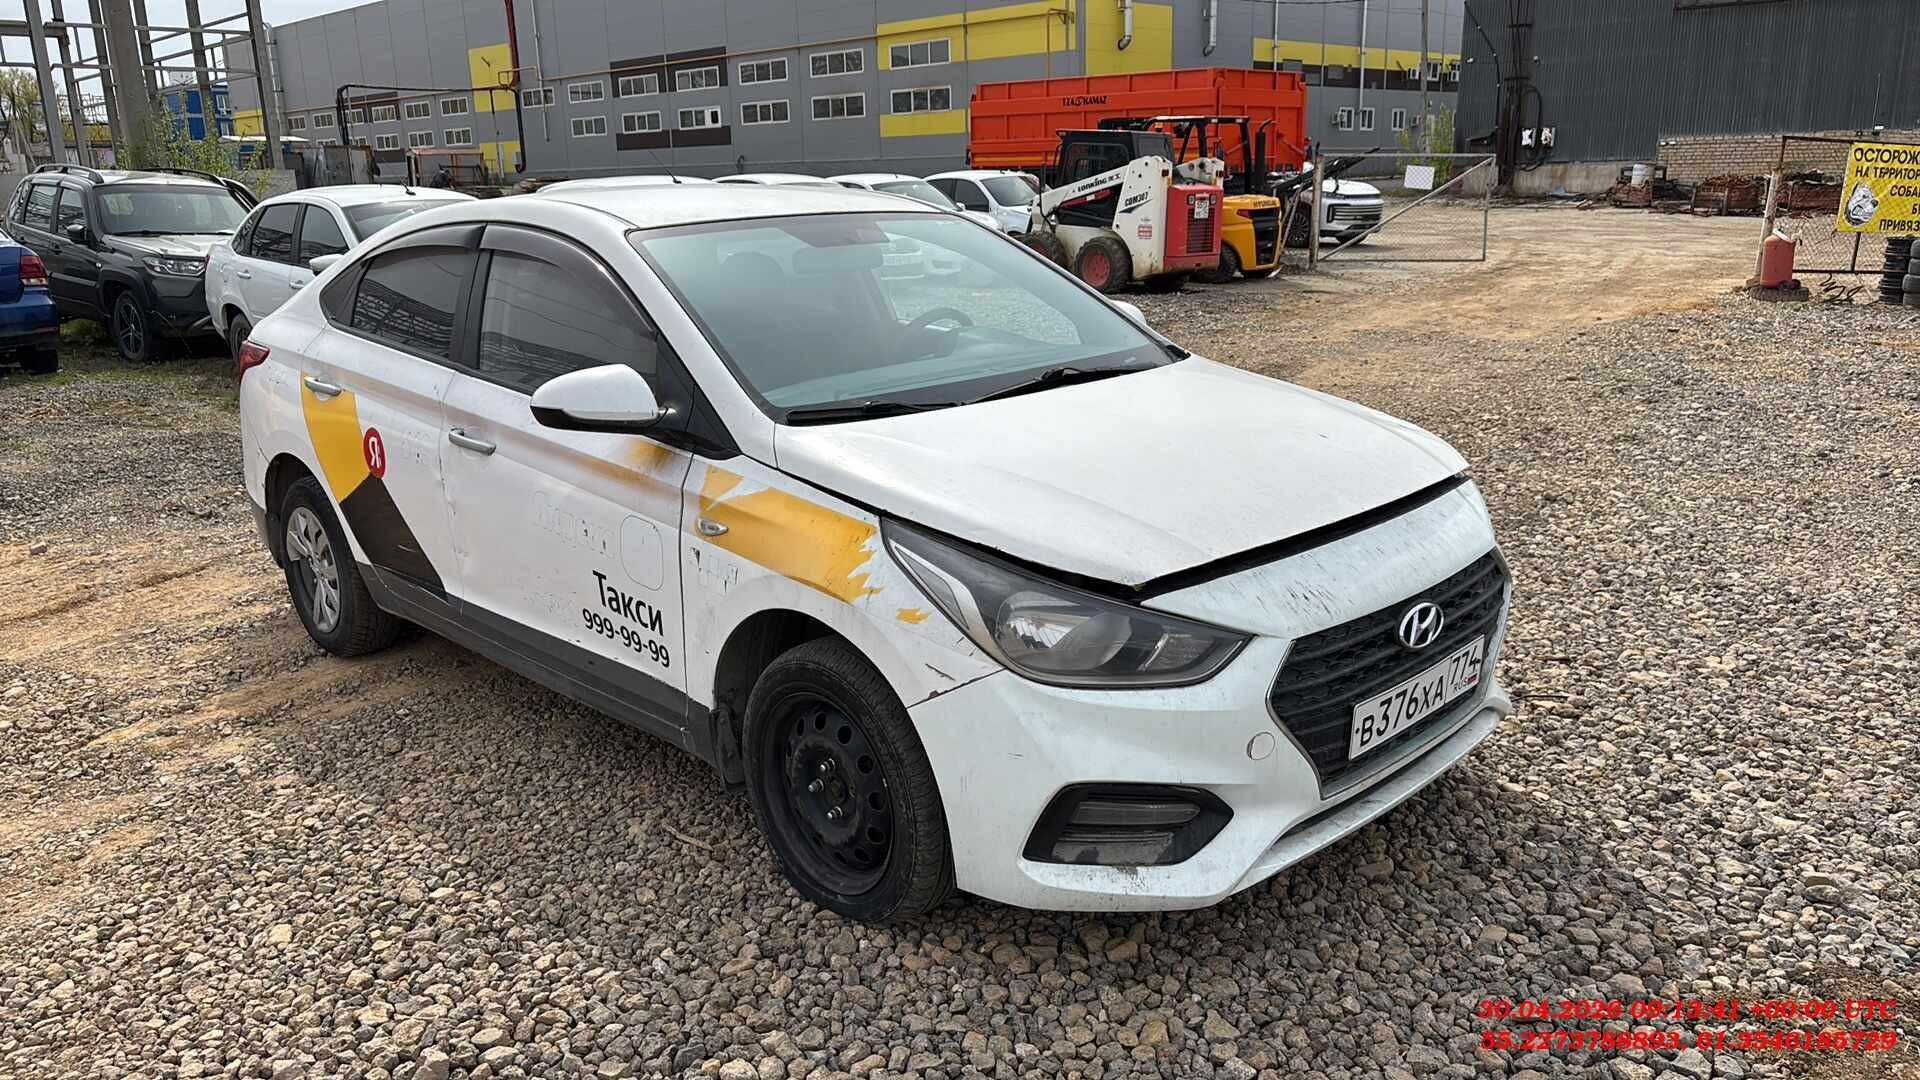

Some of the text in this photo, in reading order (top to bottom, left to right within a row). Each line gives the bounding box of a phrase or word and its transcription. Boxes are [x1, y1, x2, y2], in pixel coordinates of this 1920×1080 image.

[1853, 147, 1920, 165] ОСТОРОЖ
[1855, 166, 1869, 178] НА
[1124, 191, 1149, 207] CDM307
[1890, 184, 1920, 199] СОБА
[1911, 203, 1920, 216] Б
[1879, 218, 1920, 232] ПРИВЯЗ
[592, 569, 664, 636] Такси
[582, 608, 670, 669] 999-99-99
[1359, 645, 1480, 748] В376ХА 774
